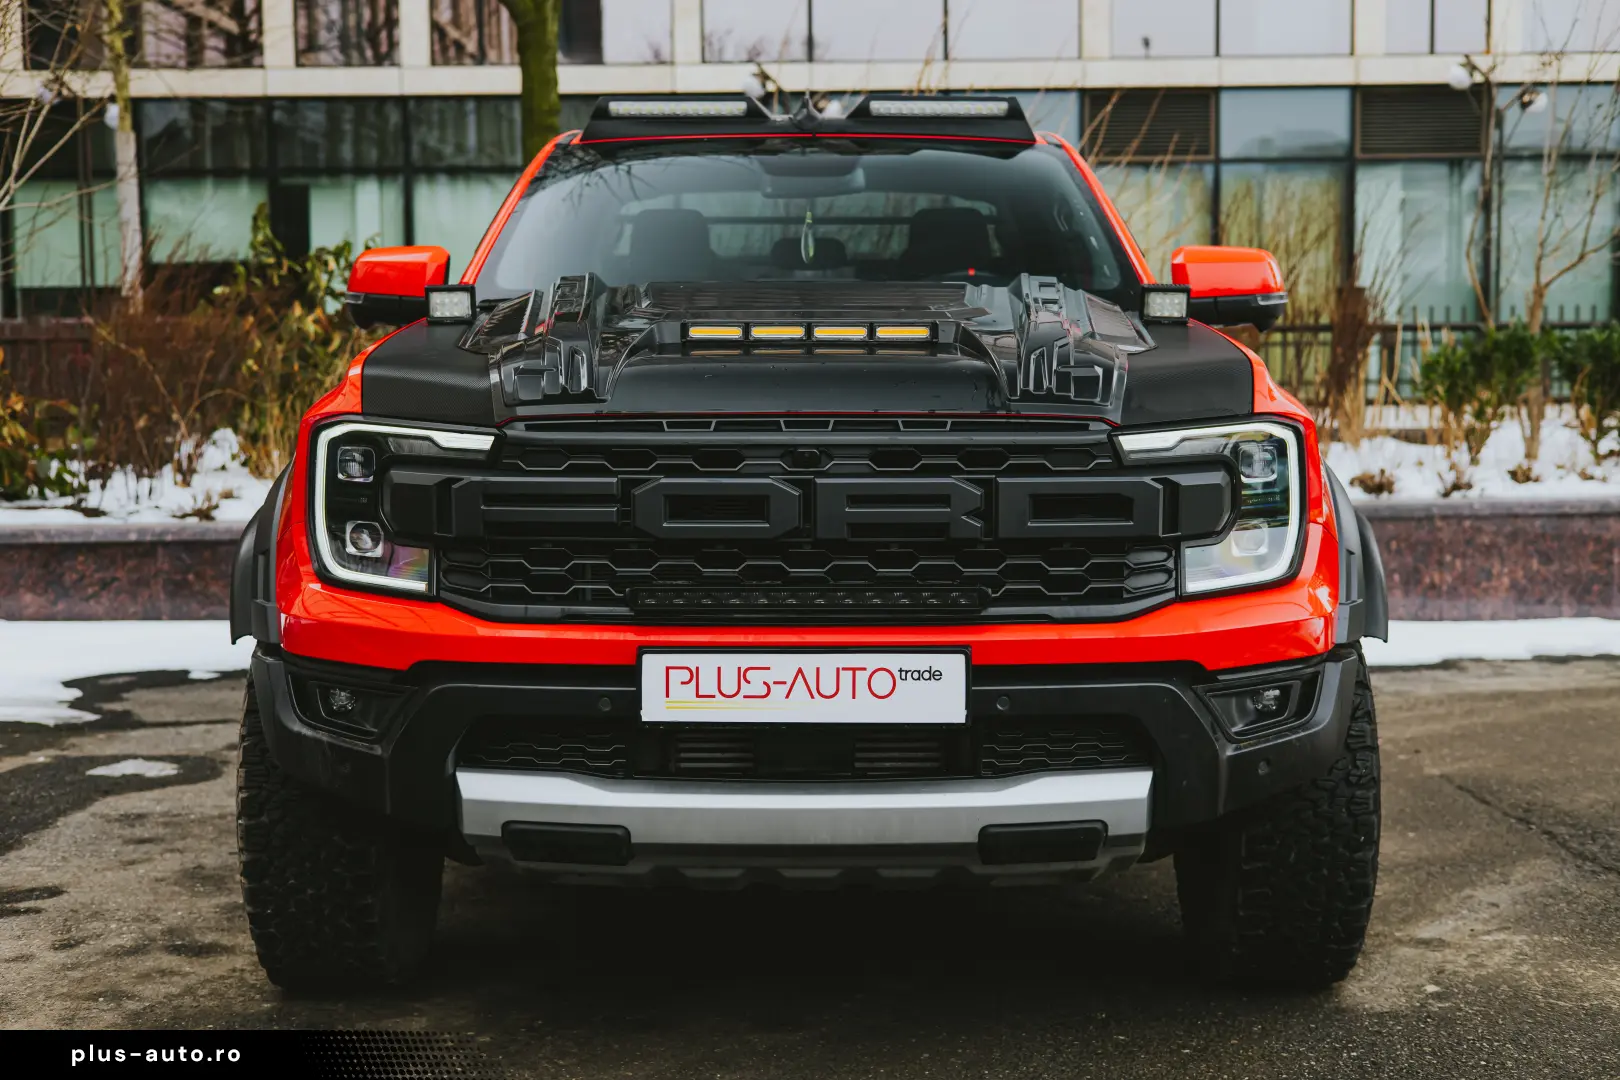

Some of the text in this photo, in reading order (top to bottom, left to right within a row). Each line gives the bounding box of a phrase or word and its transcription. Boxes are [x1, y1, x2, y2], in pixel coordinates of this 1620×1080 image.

[451, 475, 1164, 541] FORD
[665, 666, 943, 700] PLUS-AUTO trade
